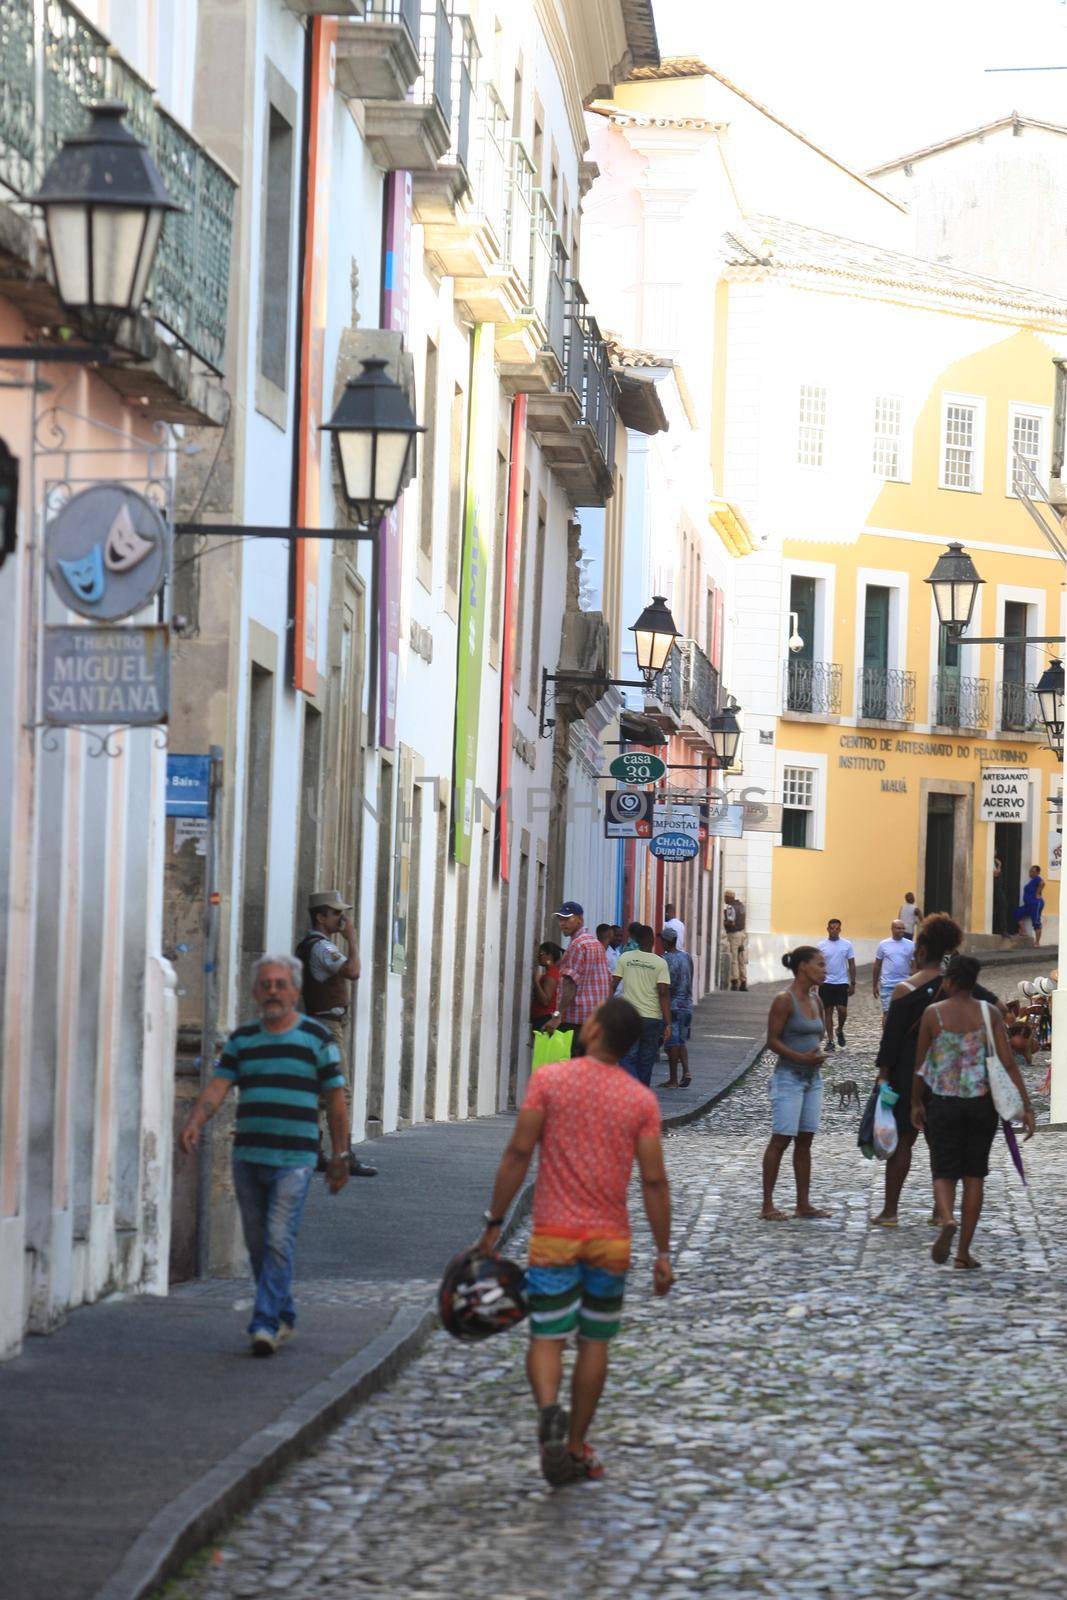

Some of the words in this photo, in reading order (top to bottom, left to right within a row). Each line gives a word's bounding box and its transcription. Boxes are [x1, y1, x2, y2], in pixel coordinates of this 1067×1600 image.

[54, 655, 155, 682] MIGUEL
[47, 685, 160, 713] SANTANA
[839, 735, 877, 750] CENTRO
[880, 738, 892, 751] DE
[895, 740, 953, 757] ARTESANATO
[957, 745, 970, 758] DO
[623, 754, 652, 764] casa
[839, 756, 886, 771] INSTITUTO
[625, 765, 651, 783] 39
[991, 784, 1018, 794] LOJA
[983, 798, 1025, 808] ACERVO
[638, 824, 649, 833] 41
